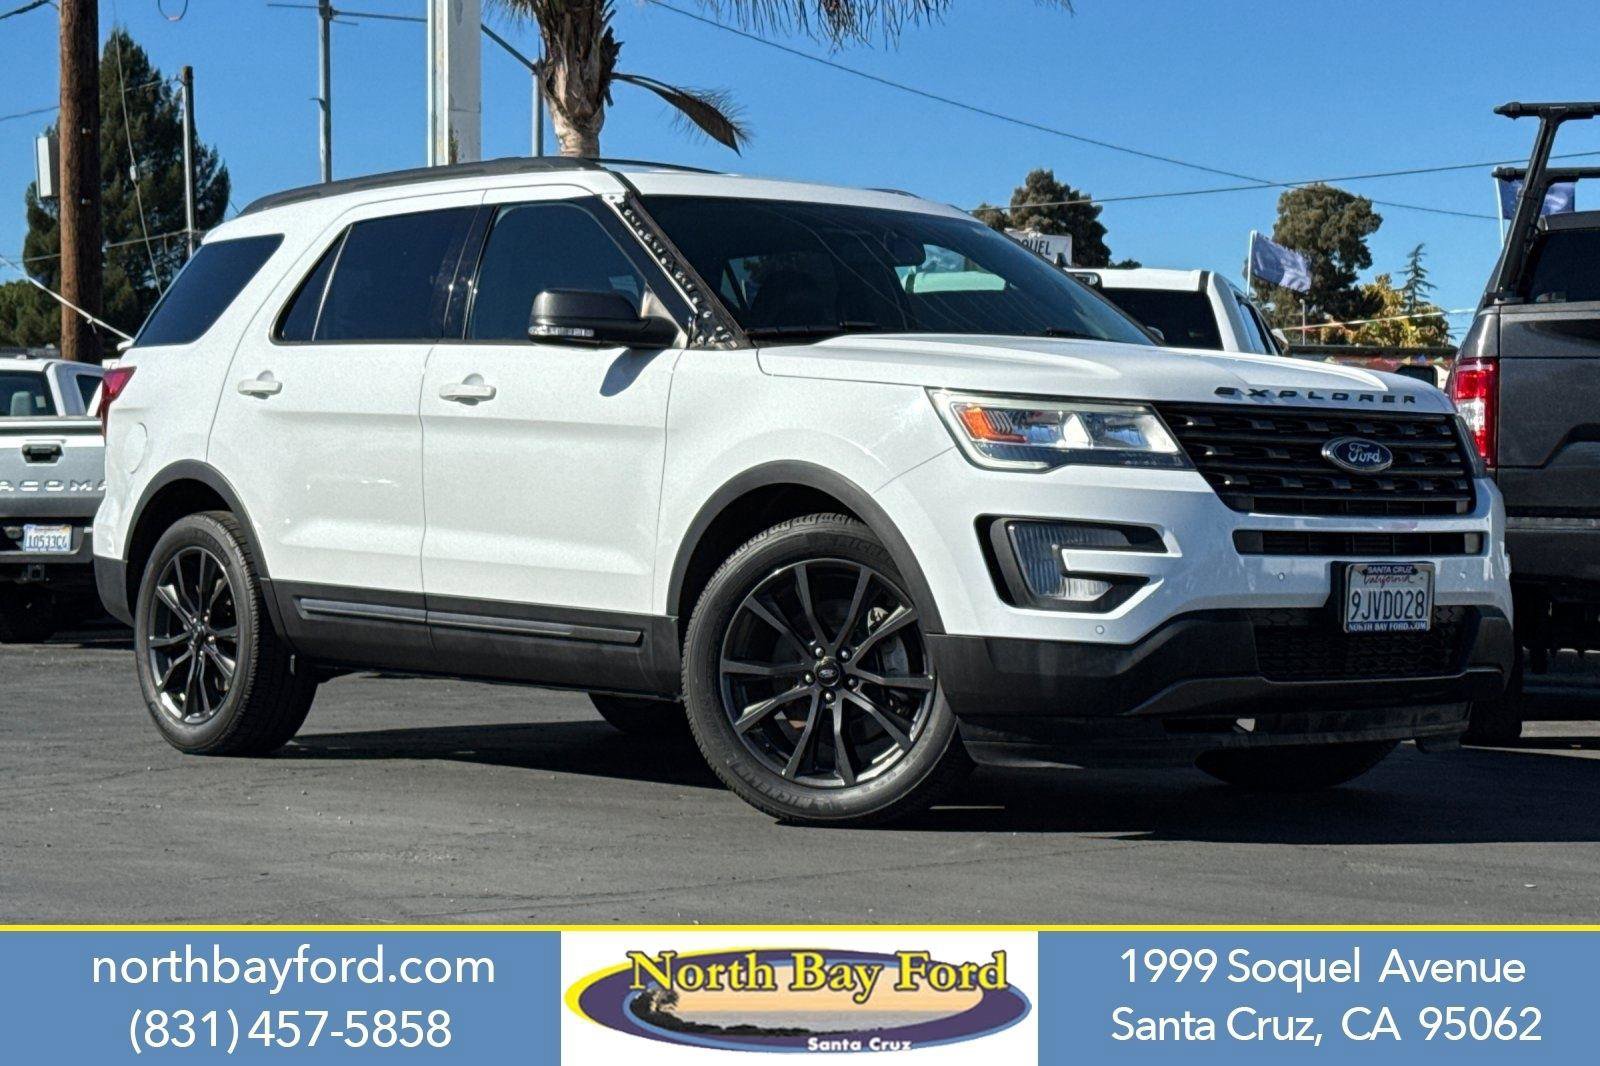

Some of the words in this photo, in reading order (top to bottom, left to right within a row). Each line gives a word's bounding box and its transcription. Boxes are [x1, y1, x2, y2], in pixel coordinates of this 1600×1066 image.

[1214, 386, 1416, 404] EXPLORER
[1348, 442, 1383, 464] Ford
[1351, 590, 1425, 620] 9JVD028
